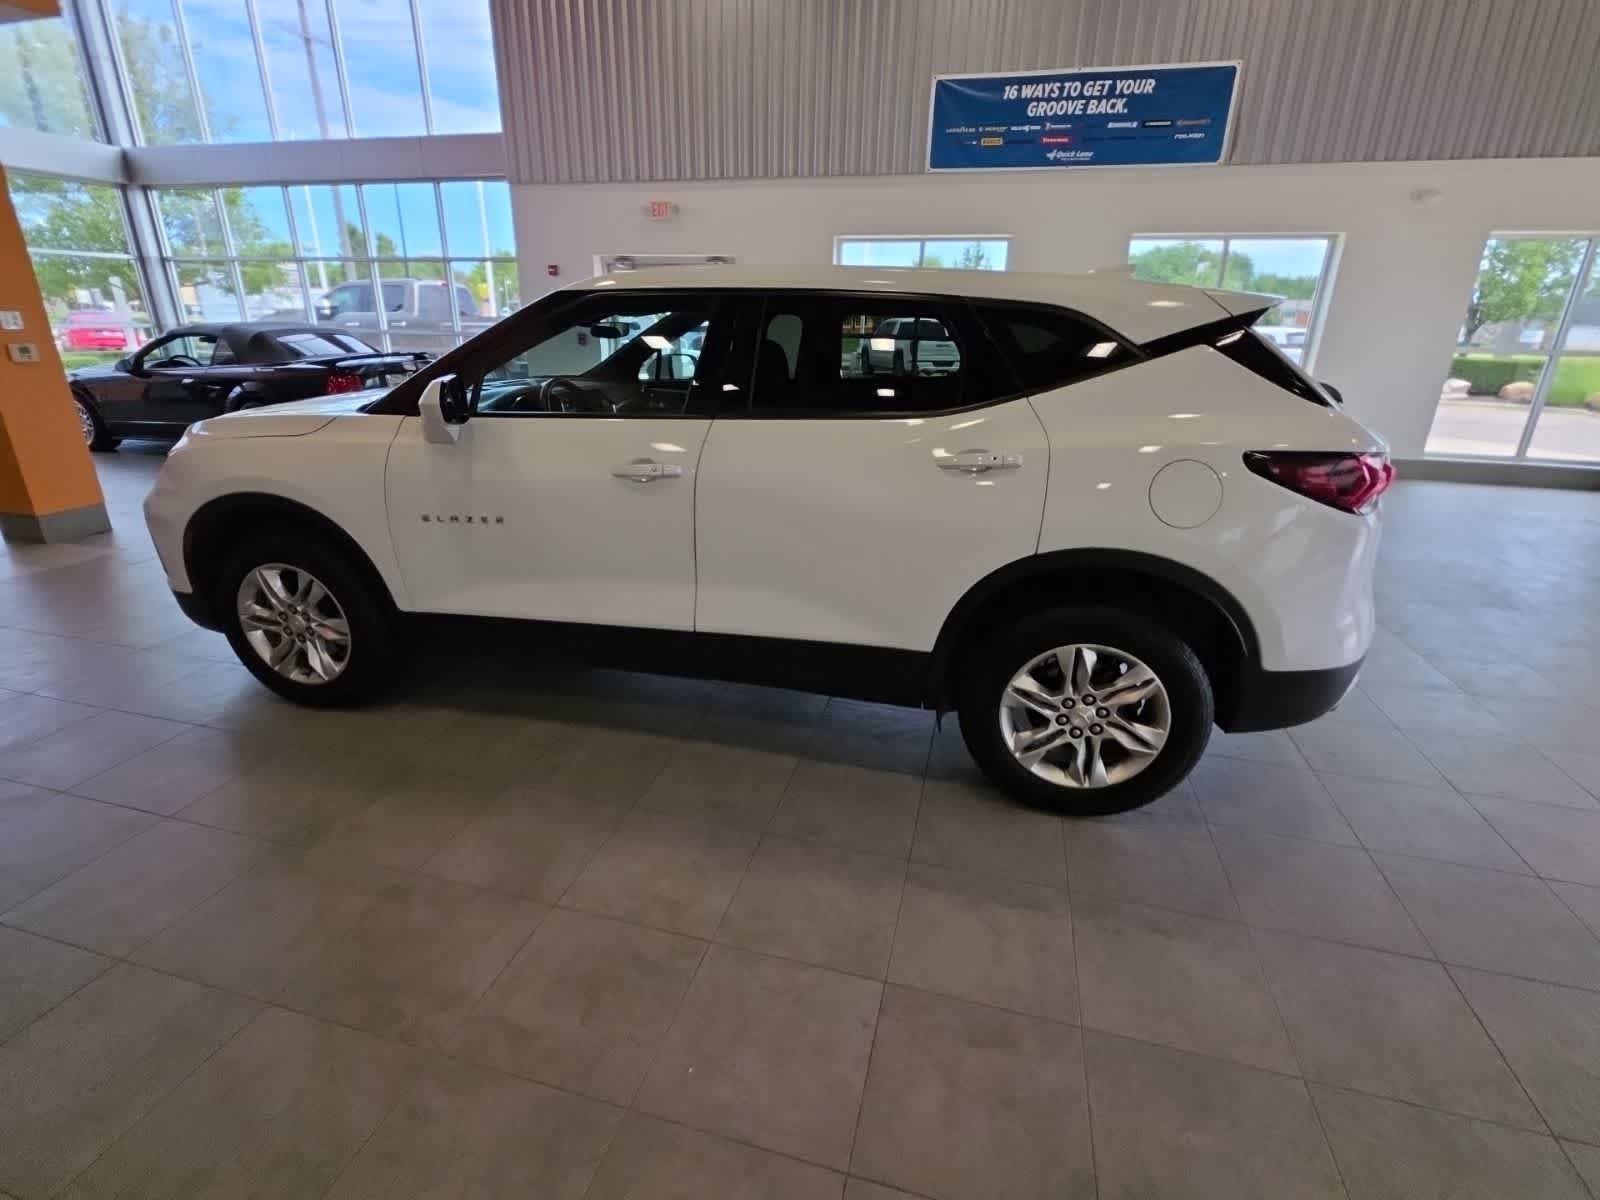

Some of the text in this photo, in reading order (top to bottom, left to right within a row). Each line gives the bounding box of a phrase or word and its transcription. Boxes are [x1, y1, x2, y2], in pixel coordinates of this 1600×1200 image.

[1003, 79, 1156, 100] 16 WAYS TO GET YOUR
[1027, 98, 1128, 117] GROOVE BACK.
[421, 514, 504, 524] BLAZER
